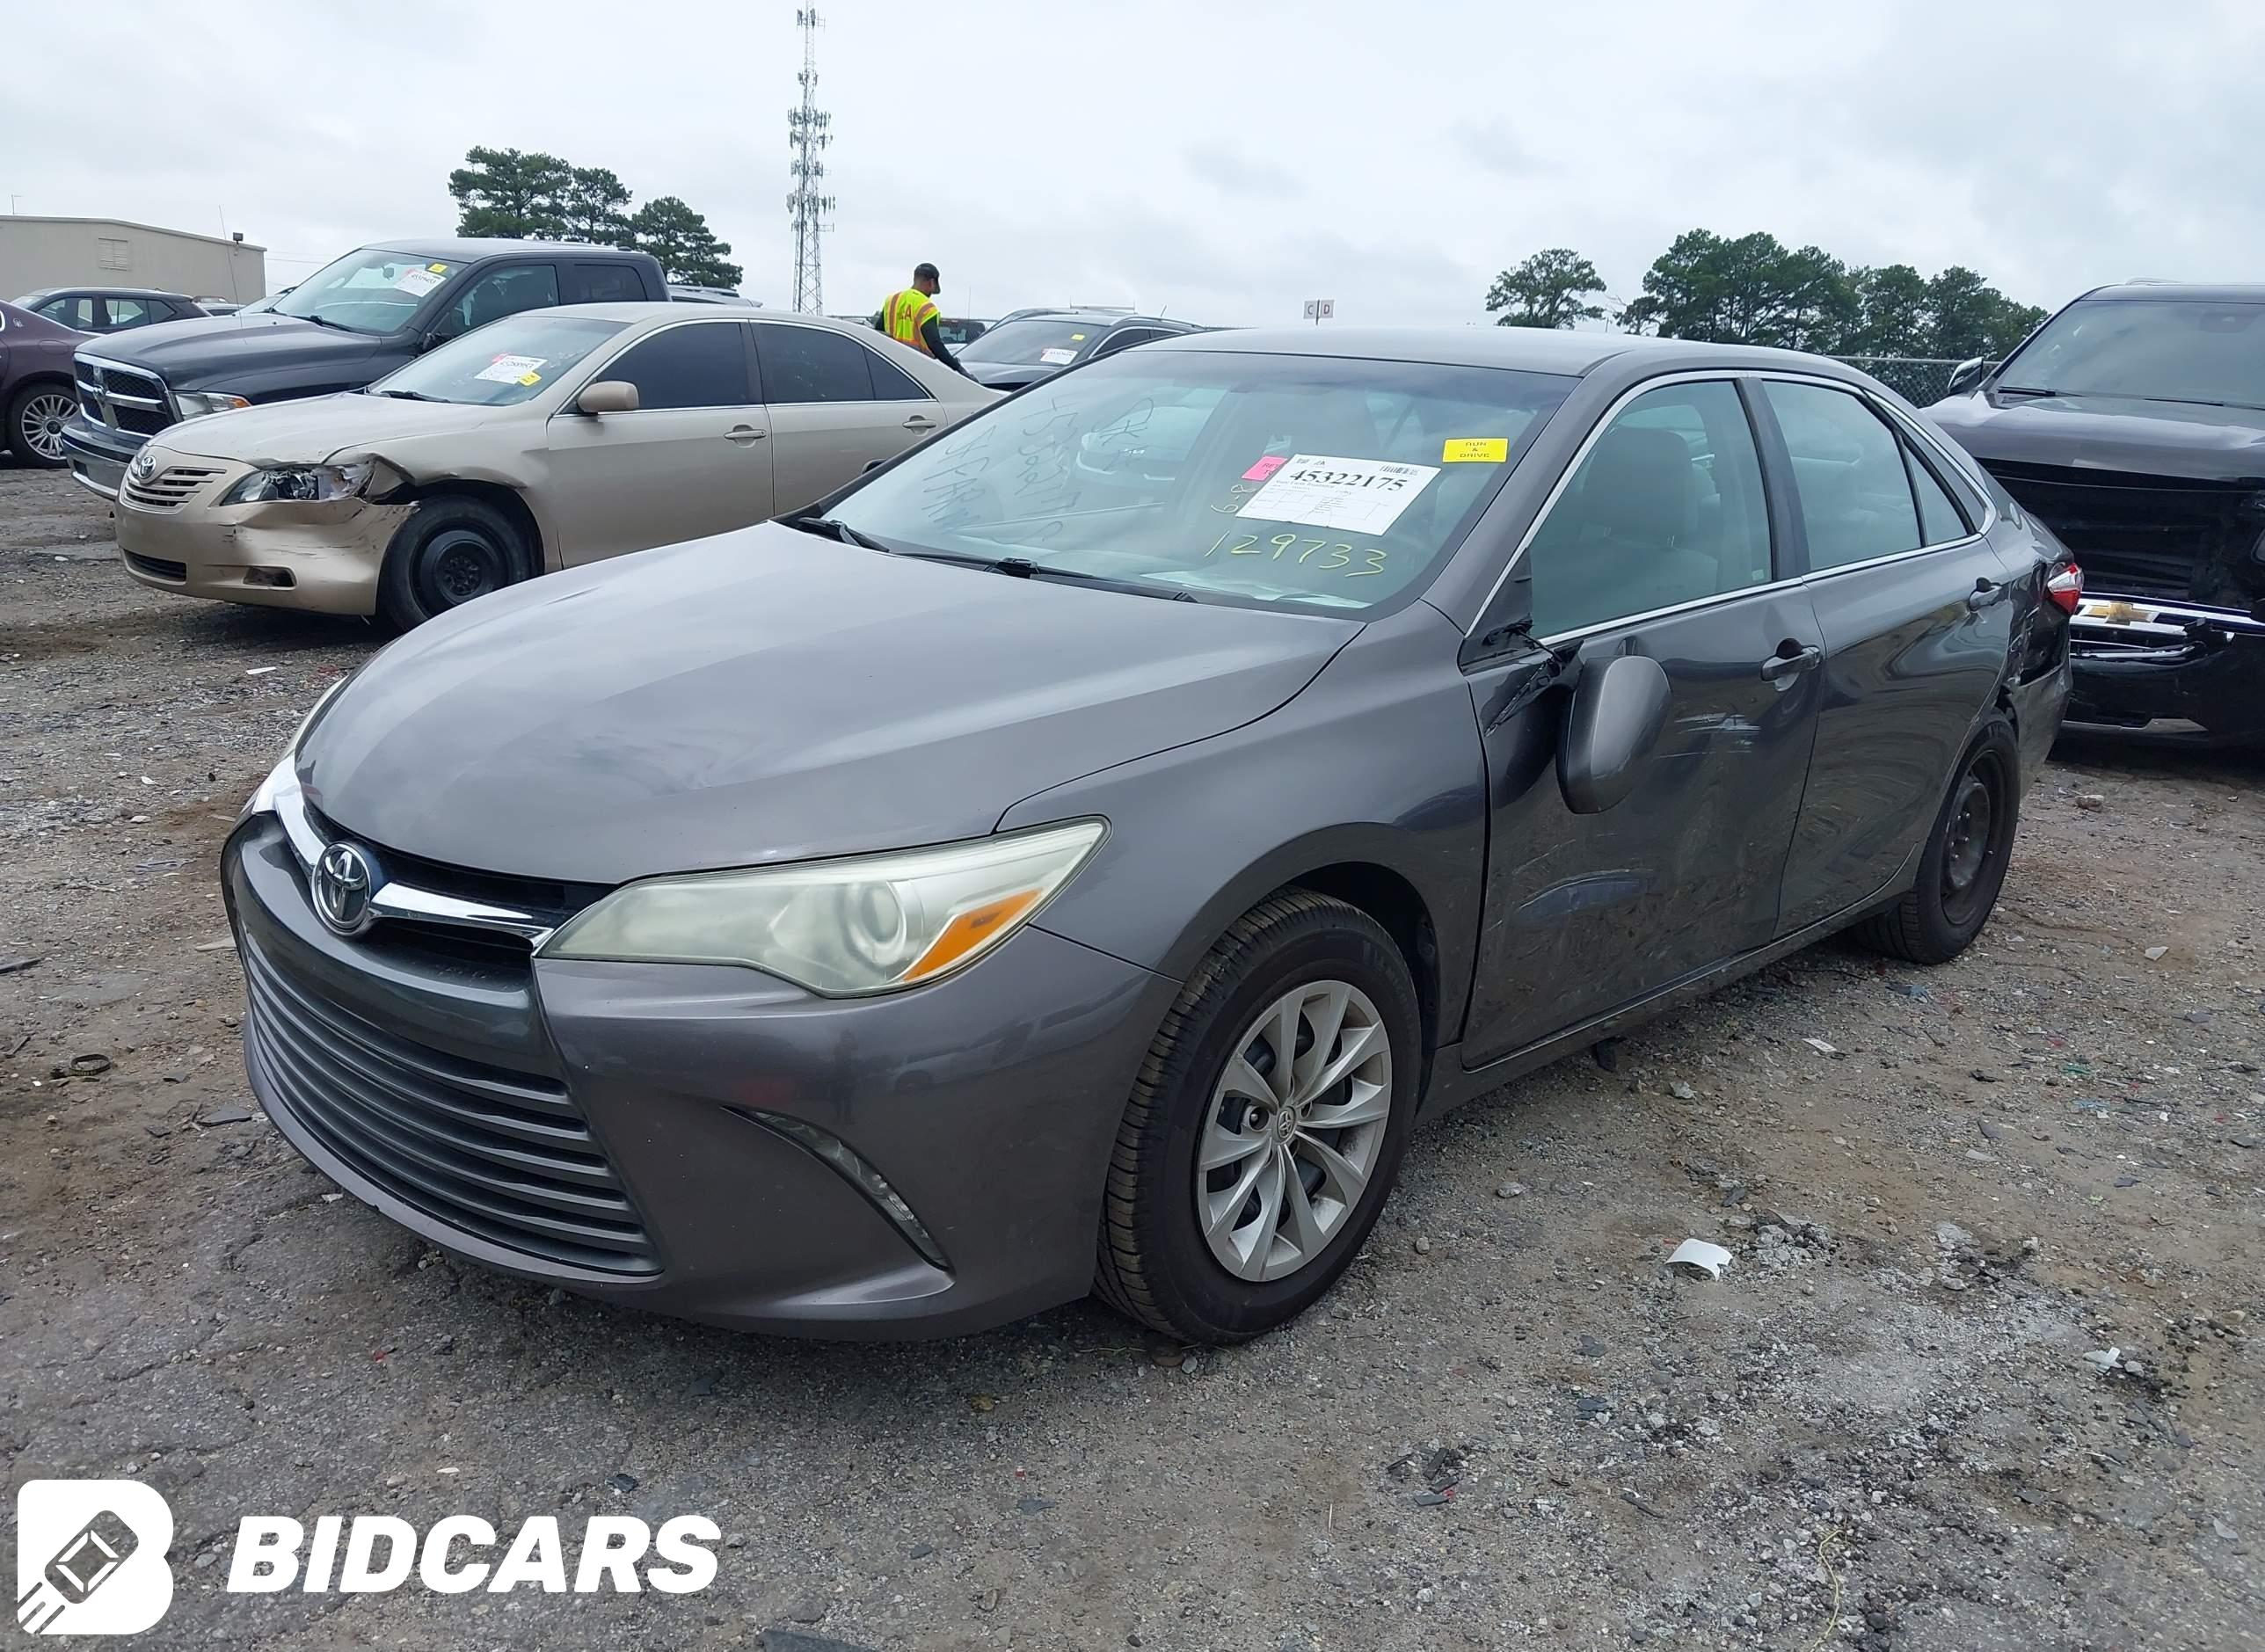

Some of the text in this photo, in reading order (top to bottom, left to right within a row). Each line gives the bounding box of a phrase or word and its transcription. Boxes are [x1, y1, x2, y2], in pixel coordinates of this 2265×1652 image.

[1307, 304, 1314, 315] C
[1323, 304, 1330, 314] D
[1289, 469, 1408, 491] 45322175
[1204, 530, 1387, 577] 129733
